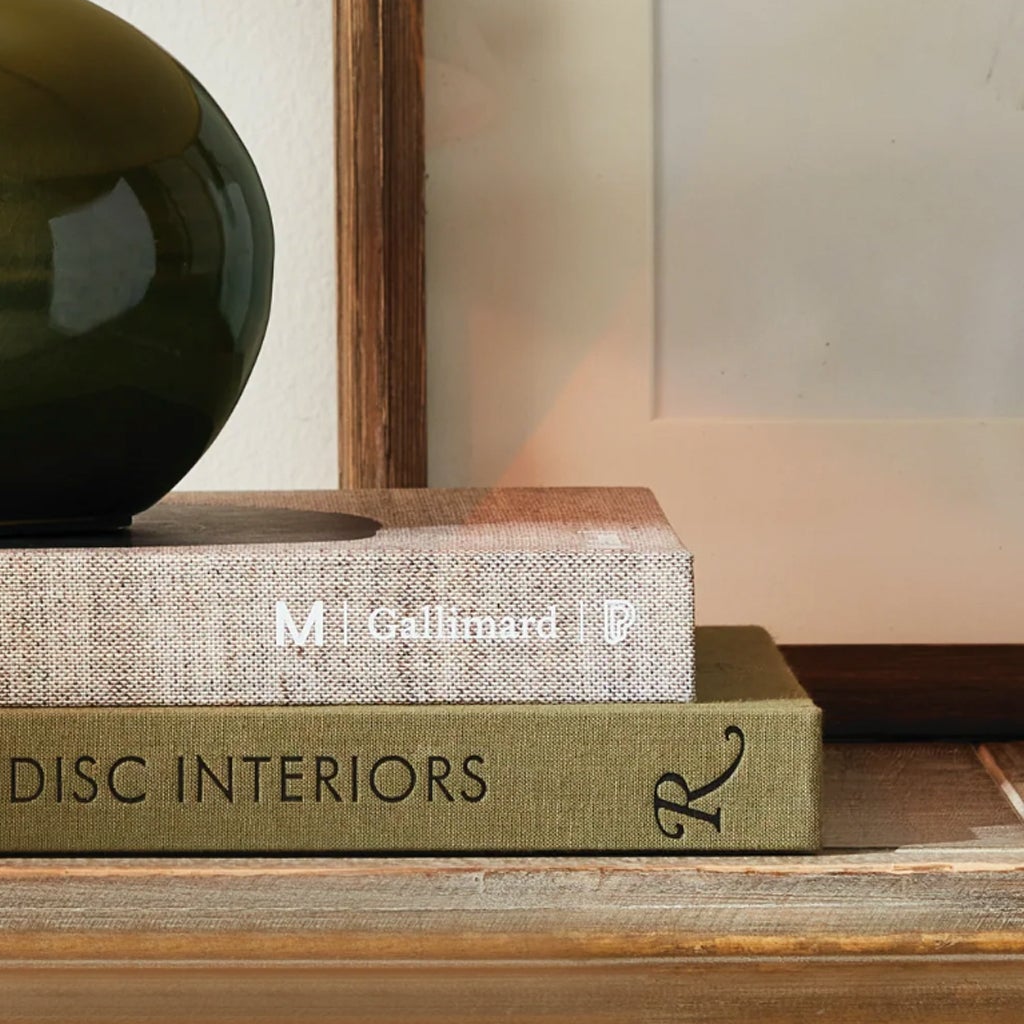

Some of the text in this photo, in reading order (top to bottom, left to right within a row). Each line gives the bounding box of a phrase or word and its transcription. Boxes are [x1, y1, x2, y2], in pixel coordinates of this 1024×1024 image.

[275, 601, 325, 647] M
[367, 604, 558, 641] Gallimard
[10, 754, 147, 804] DISC
[176, 754, 489, 804] INTERIORS
[653, 725, 745, 840] R
